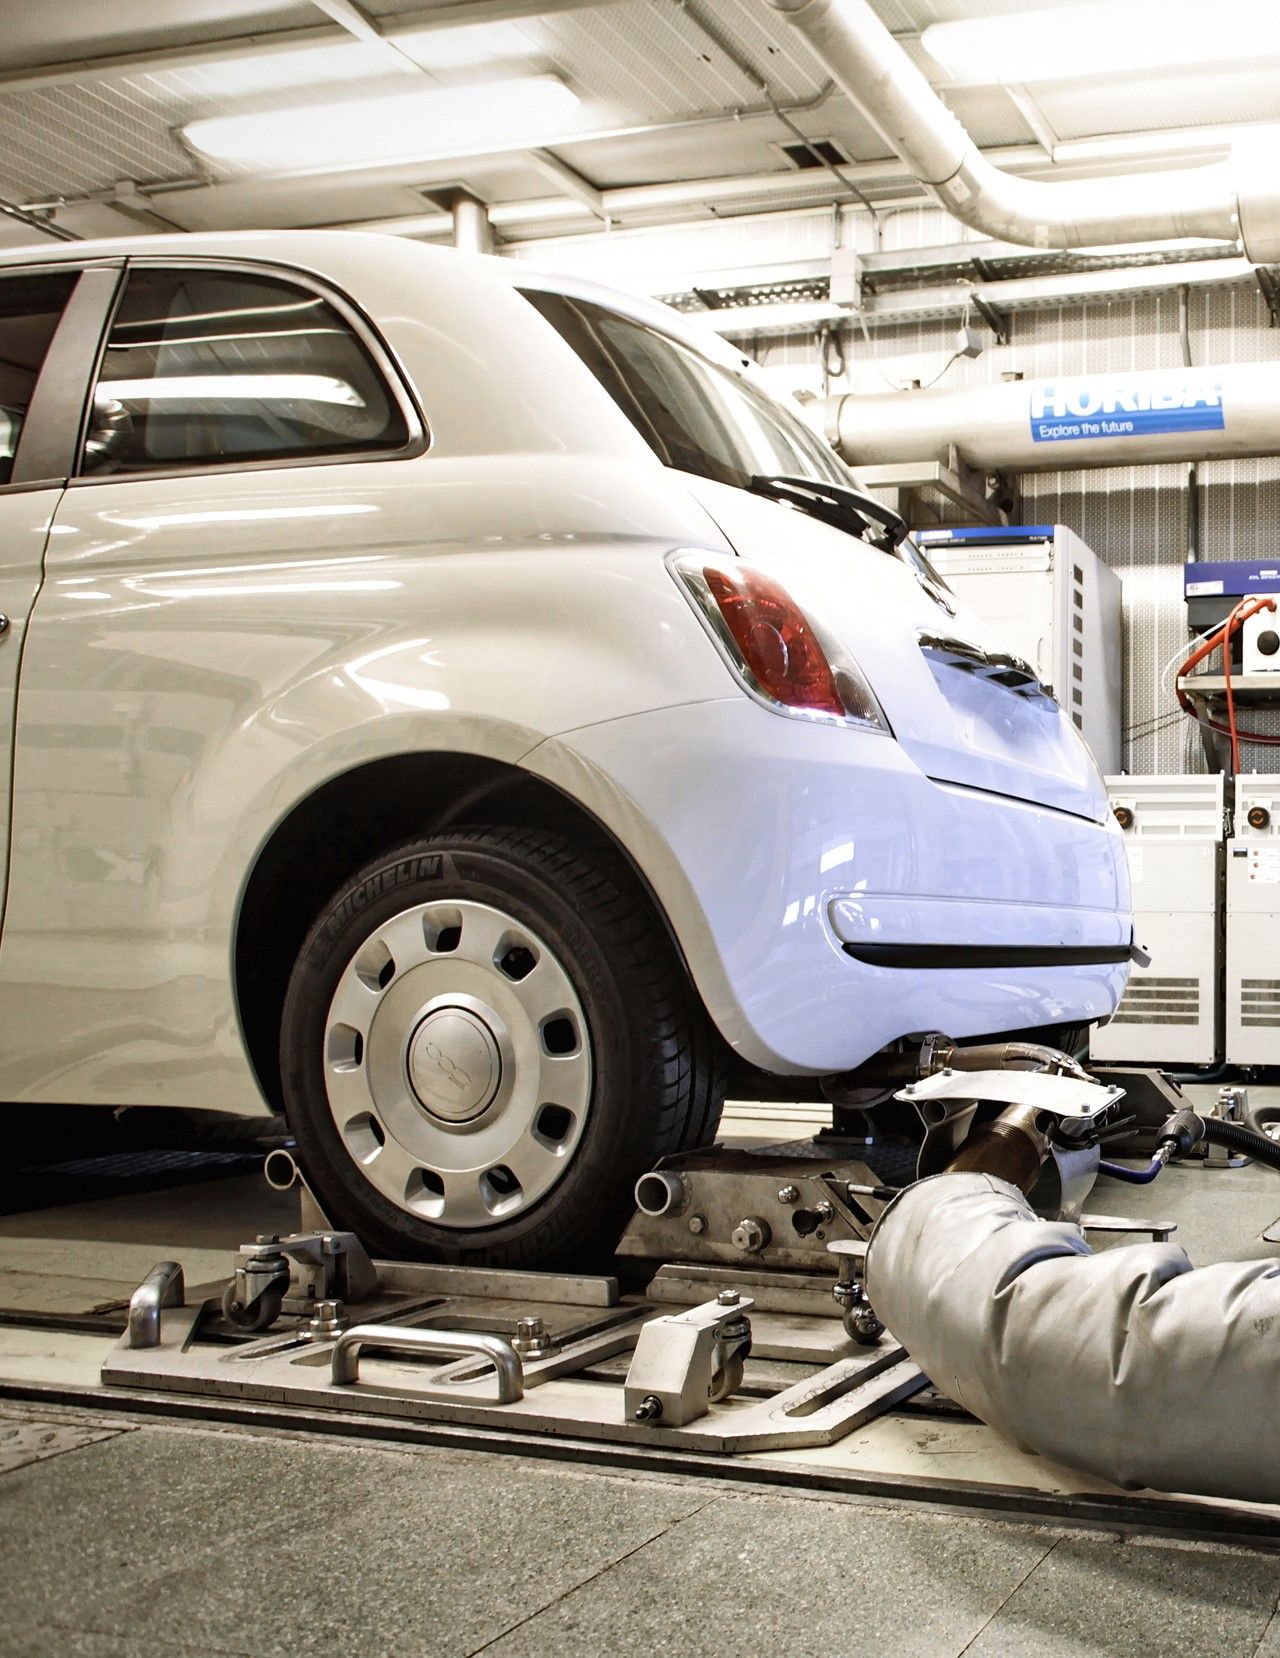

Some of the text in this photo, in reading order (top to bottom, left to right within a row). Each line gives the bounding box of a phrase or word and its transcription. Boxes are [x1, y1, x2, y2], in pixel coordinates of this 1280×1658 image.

[1031, 377, 1223, 419] HORIBA
[1039, 420, 1134, 439] Explore the future
[326, 855, 443, 938] MICHELIN
